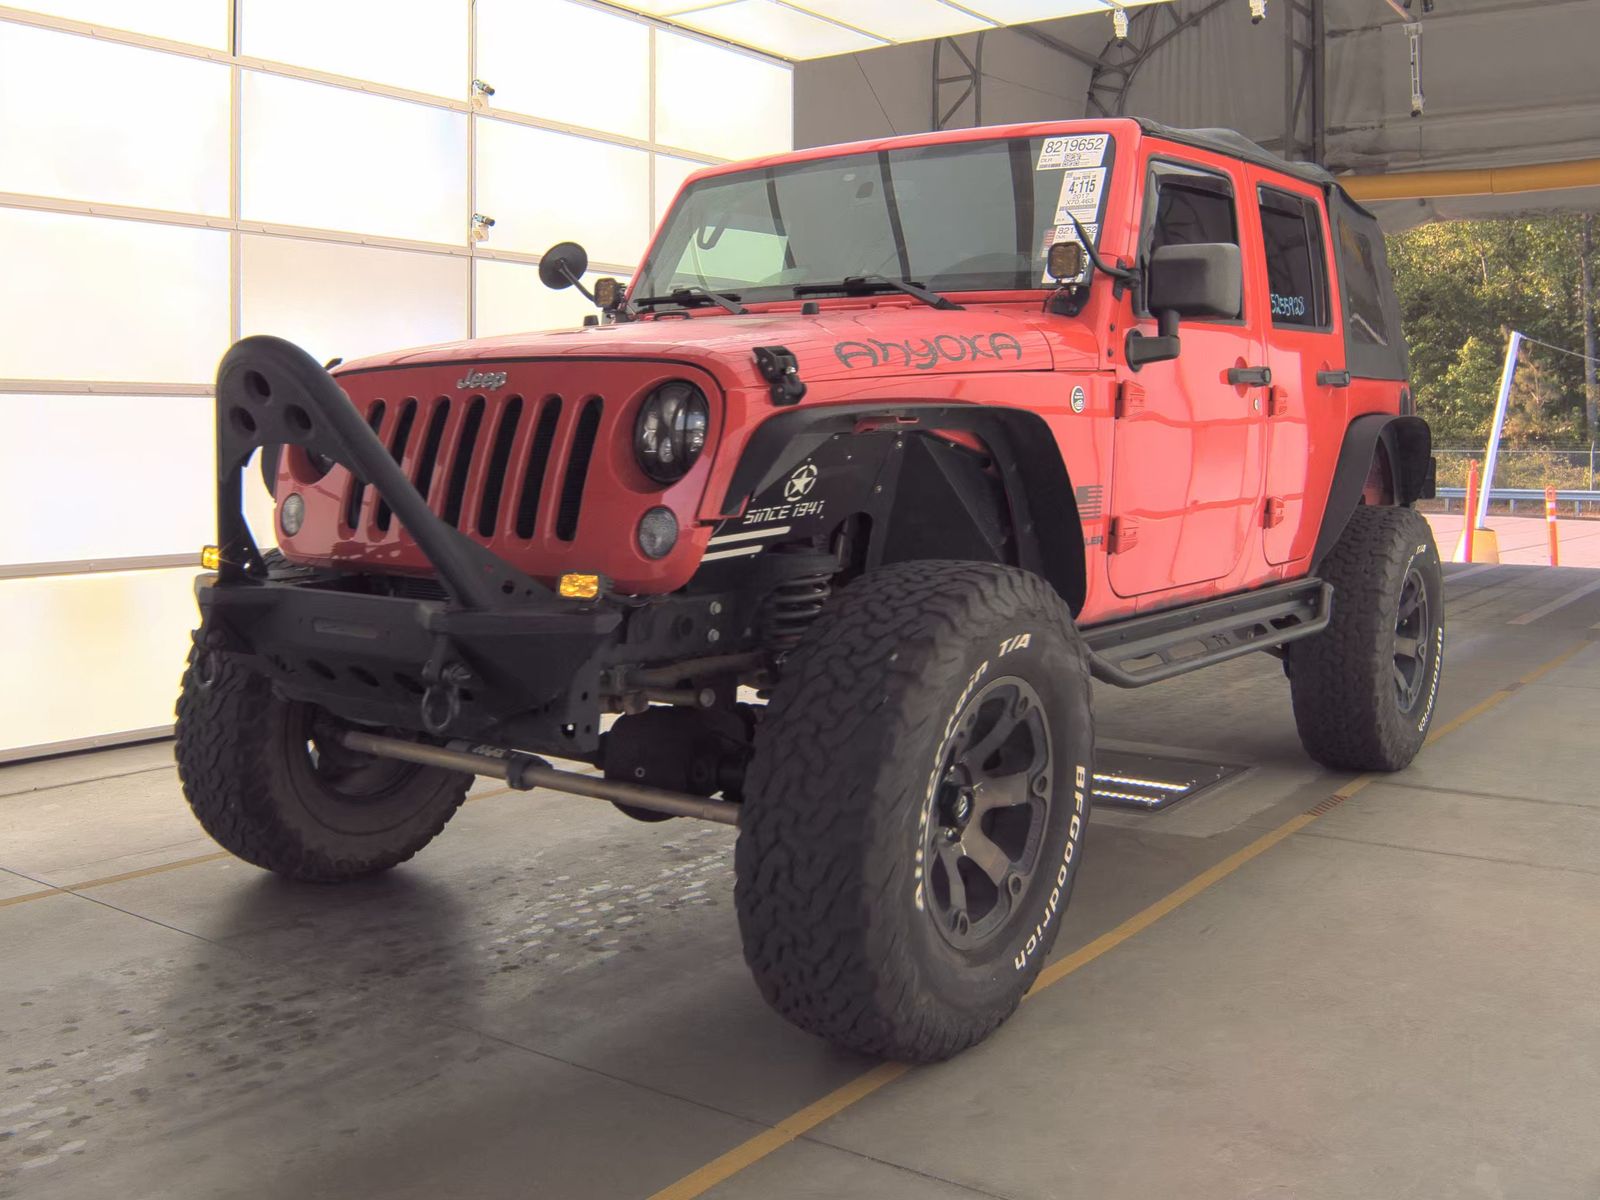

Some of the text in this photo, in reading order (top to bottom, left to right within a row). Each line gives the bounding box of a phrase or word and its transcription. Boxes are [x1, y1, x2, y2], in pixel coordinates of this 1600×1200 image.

[1045, 137, 1104, 153] 8219652
[1068, 179, 1097, 194] 4:115
[1057, 225, 1098, 235] 82152
[456, 368, 507, 391] Jeep
[742, 505, 792, 525] SINCE
[998, 633, 1032, 658] T/A
[1014, 765, 1086, 970] BFGoodrich
